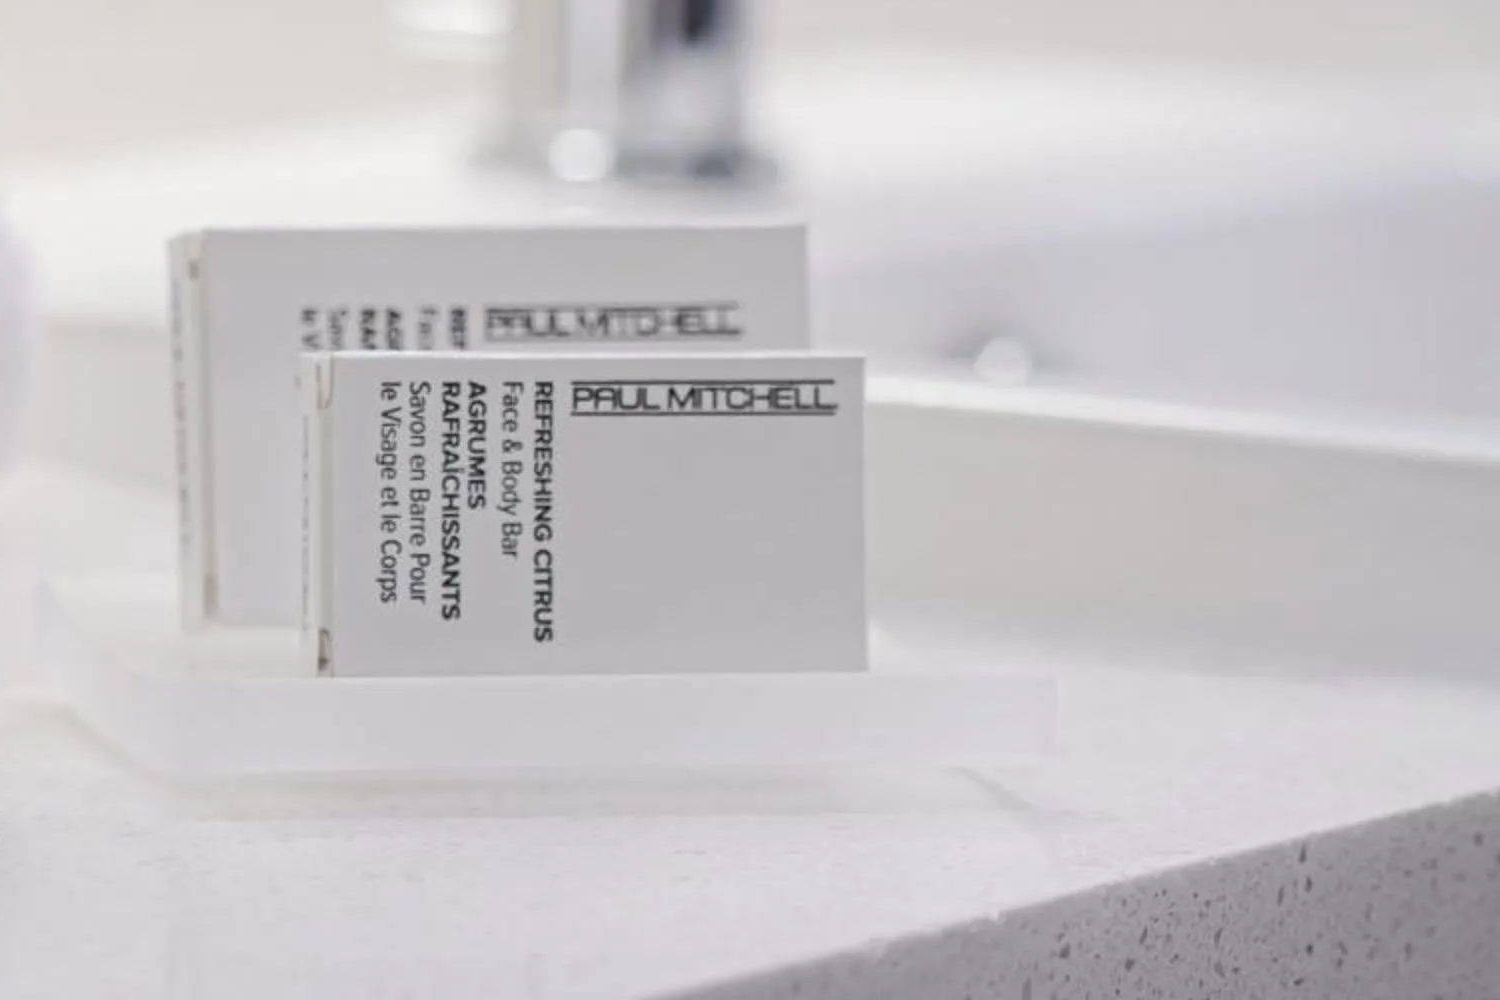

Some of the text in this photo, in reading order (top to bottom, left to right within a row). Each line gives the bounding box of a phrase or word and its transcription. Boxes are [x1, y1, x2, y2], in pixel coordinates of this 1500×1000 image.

[376, 381, 402, 604] le Visage et le Corps
[409, 381, 431, 605] Savon en Barre Pour
[467, 380, 487, 510] AGRUMES
[497, 380, 524, 559] Face & Body Bar
[572, 386, 839, 410] PAUL MITCHELL
[533, 380, 554, 643] REFRESHING CITRUS
